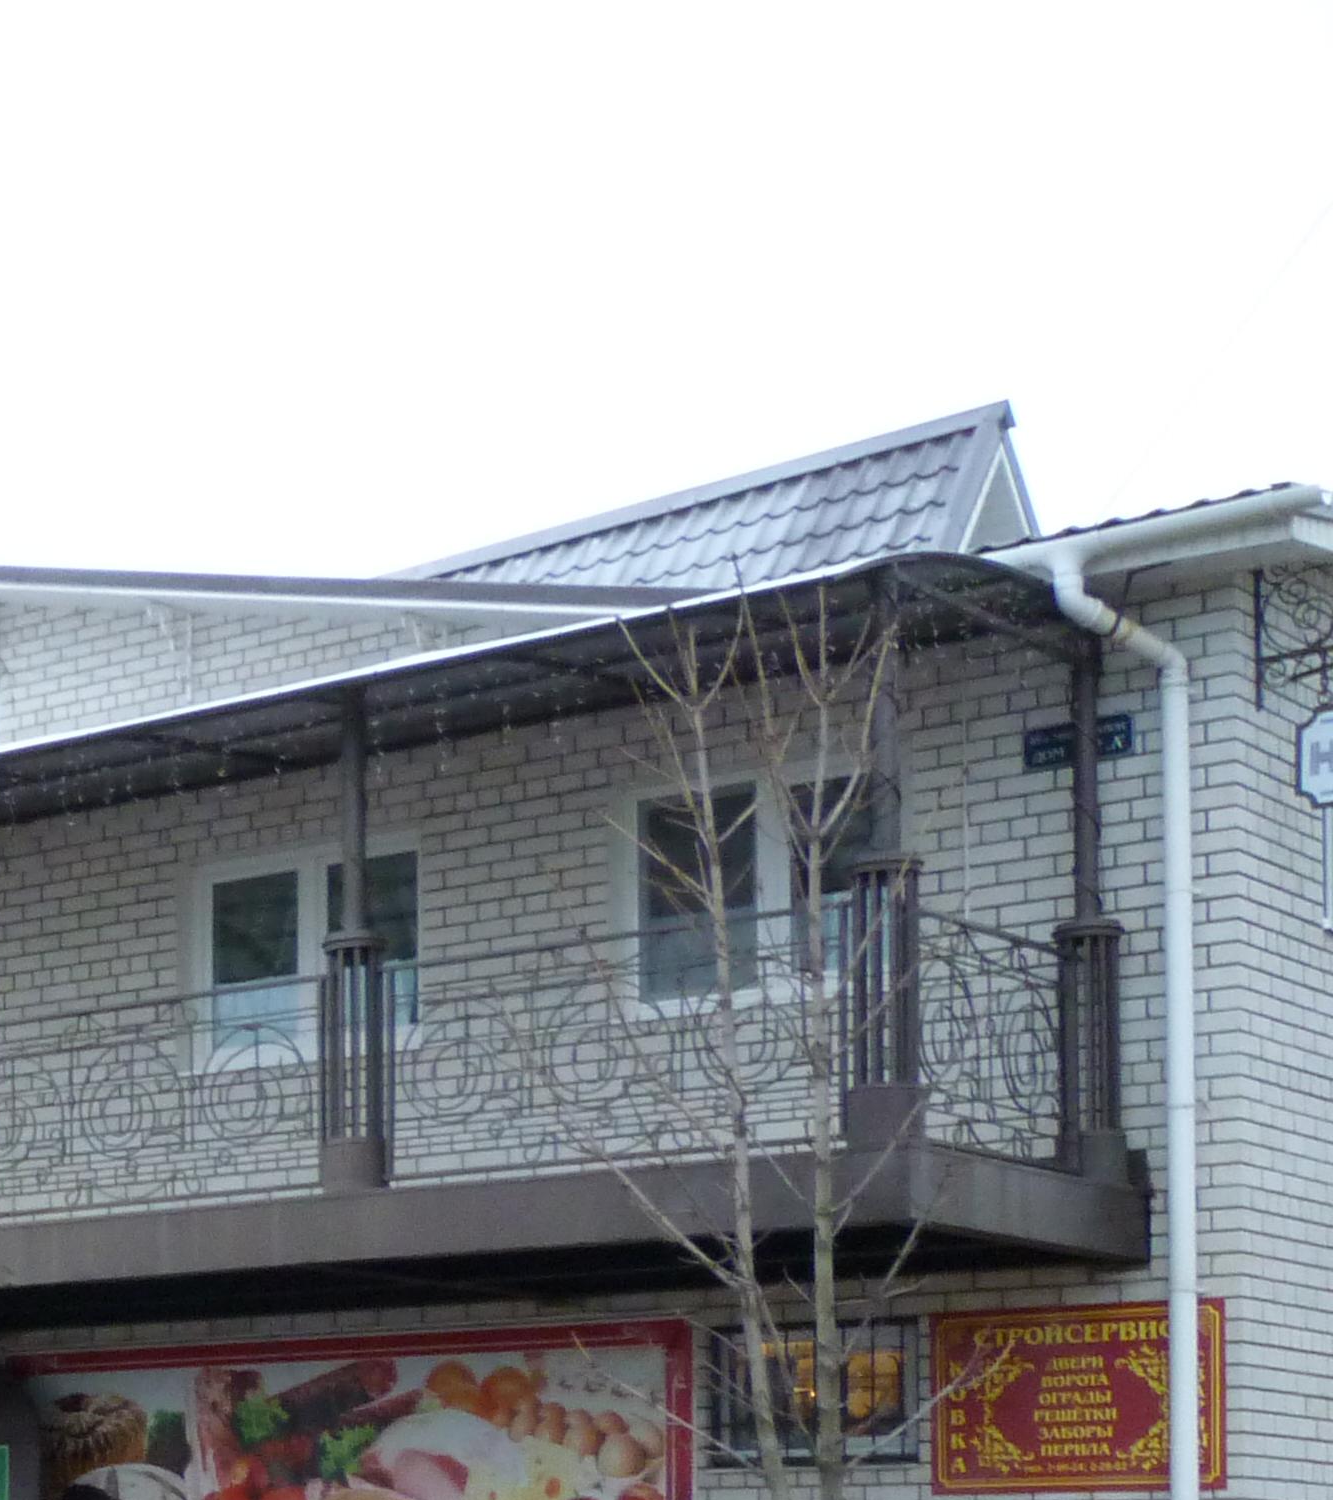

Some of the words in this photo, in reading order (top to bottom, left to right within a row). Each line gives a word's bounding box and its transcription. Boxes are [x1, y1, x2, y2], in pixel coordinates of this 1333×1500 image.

[1046, 1354, 1105, 1372] ДВЕРИ
[1040, 1372, 1110, 1389] ВОРОТА
[1038, 1389, 1113, 1406] ОГРАДЫ
[1037, 1424, 1114, 1440] ЗАБОРЫ
[1039, 1441, 1111, 1458] ПЕРИЛА
